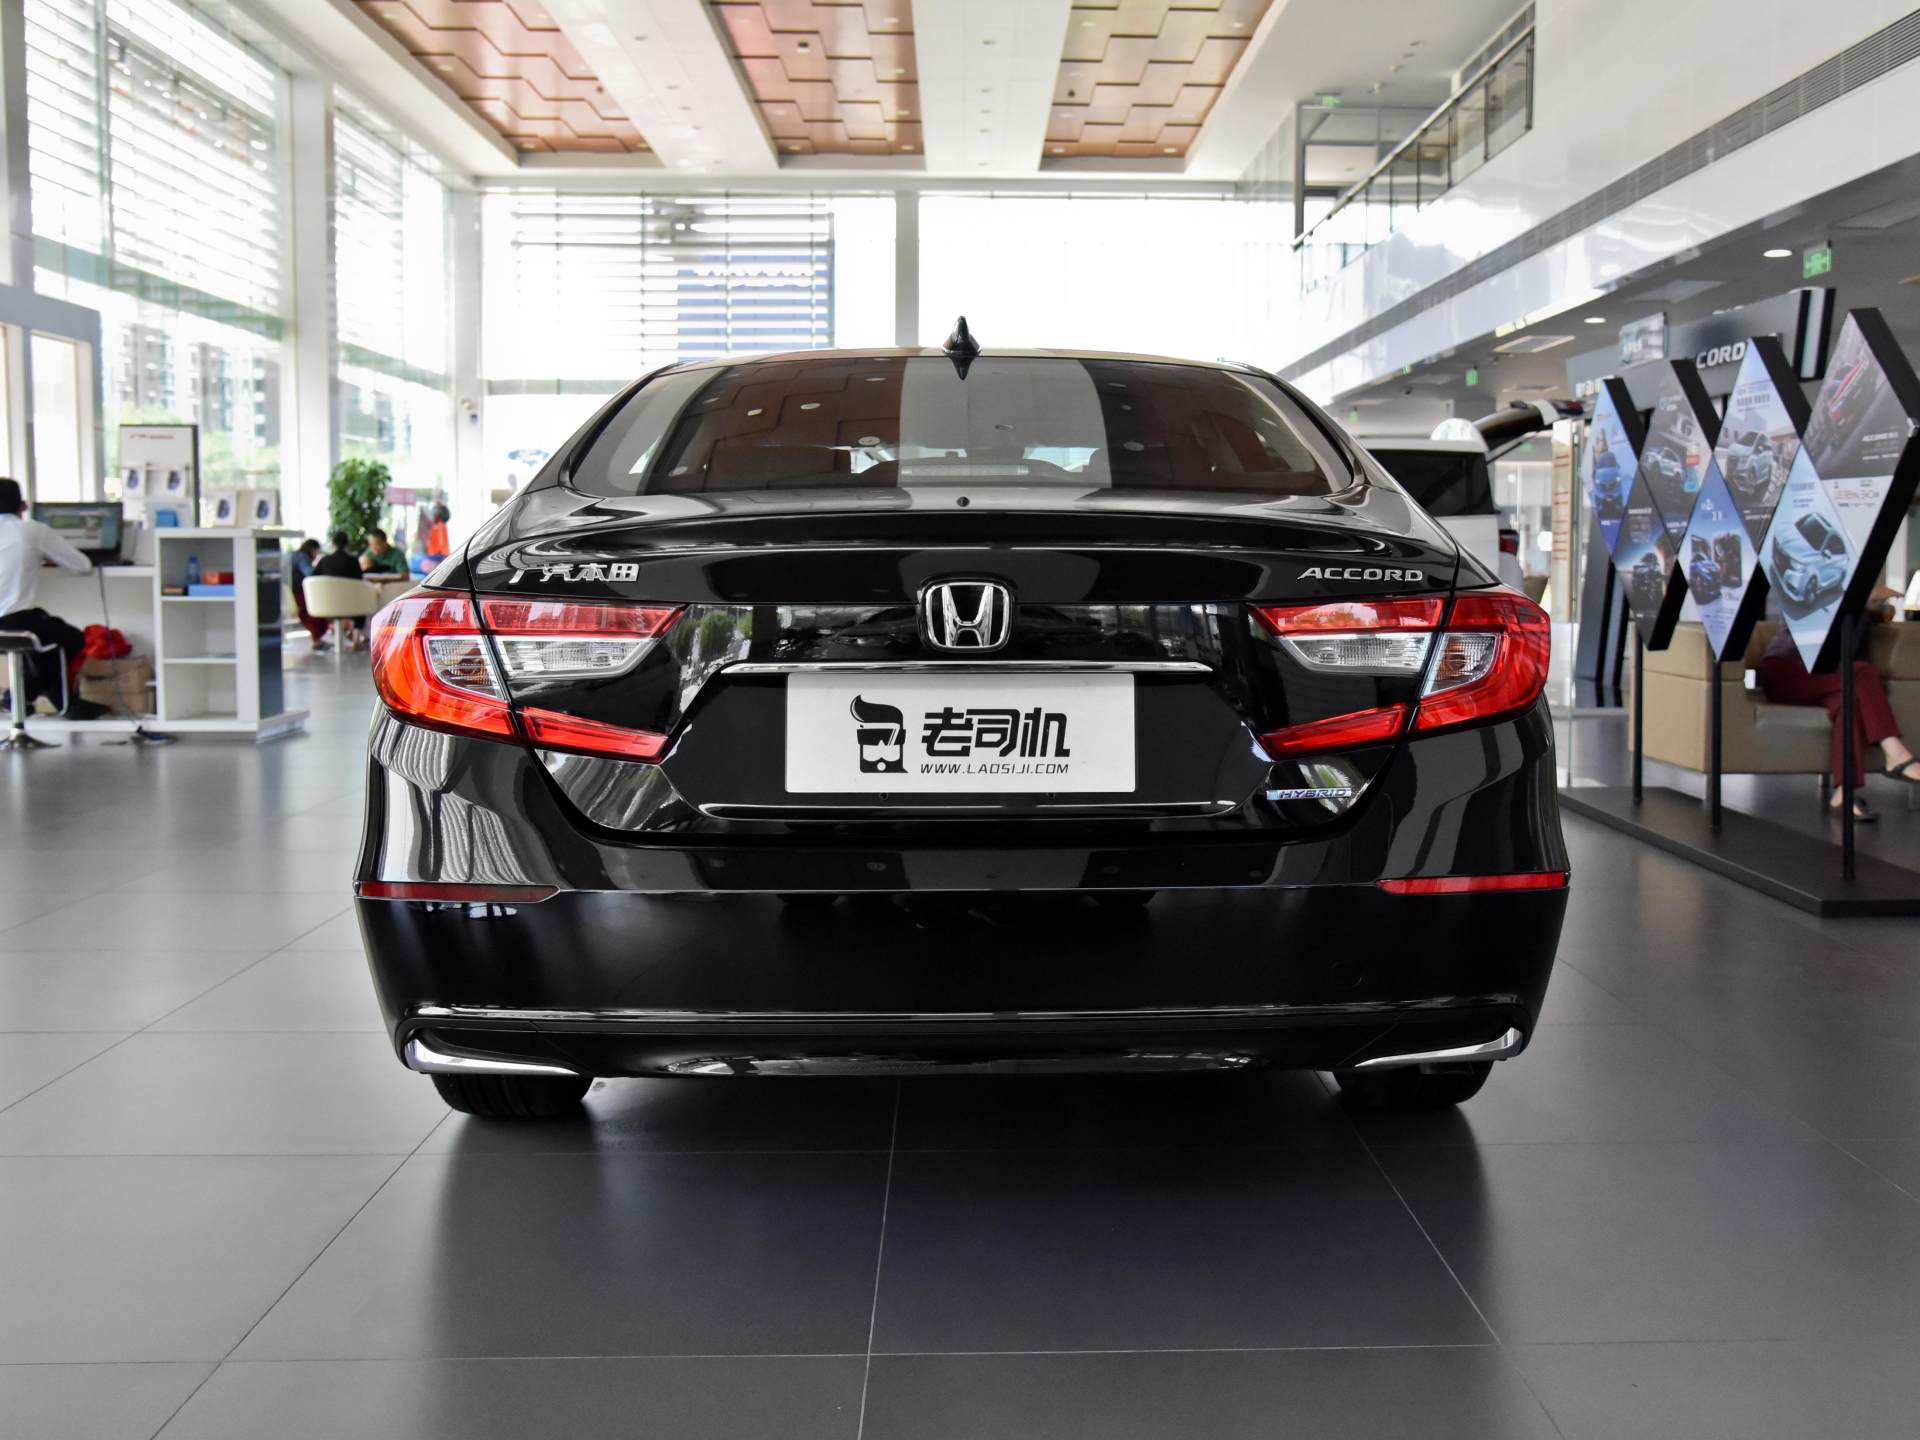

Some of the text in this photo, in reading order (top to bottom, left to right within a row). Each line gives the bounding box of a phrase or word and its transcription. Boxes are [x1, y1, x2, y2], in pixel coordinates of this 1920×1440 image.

[508, 563, 640, 583] 广汽本田
[1297, 567, 1423, 582] ACCORD
[921, 706, 1070, 757] 老司机
[920, 763, 1069, 774] WWW.LAOSIJI.COM
[1280, 788, 1348, 799] HYBRID
